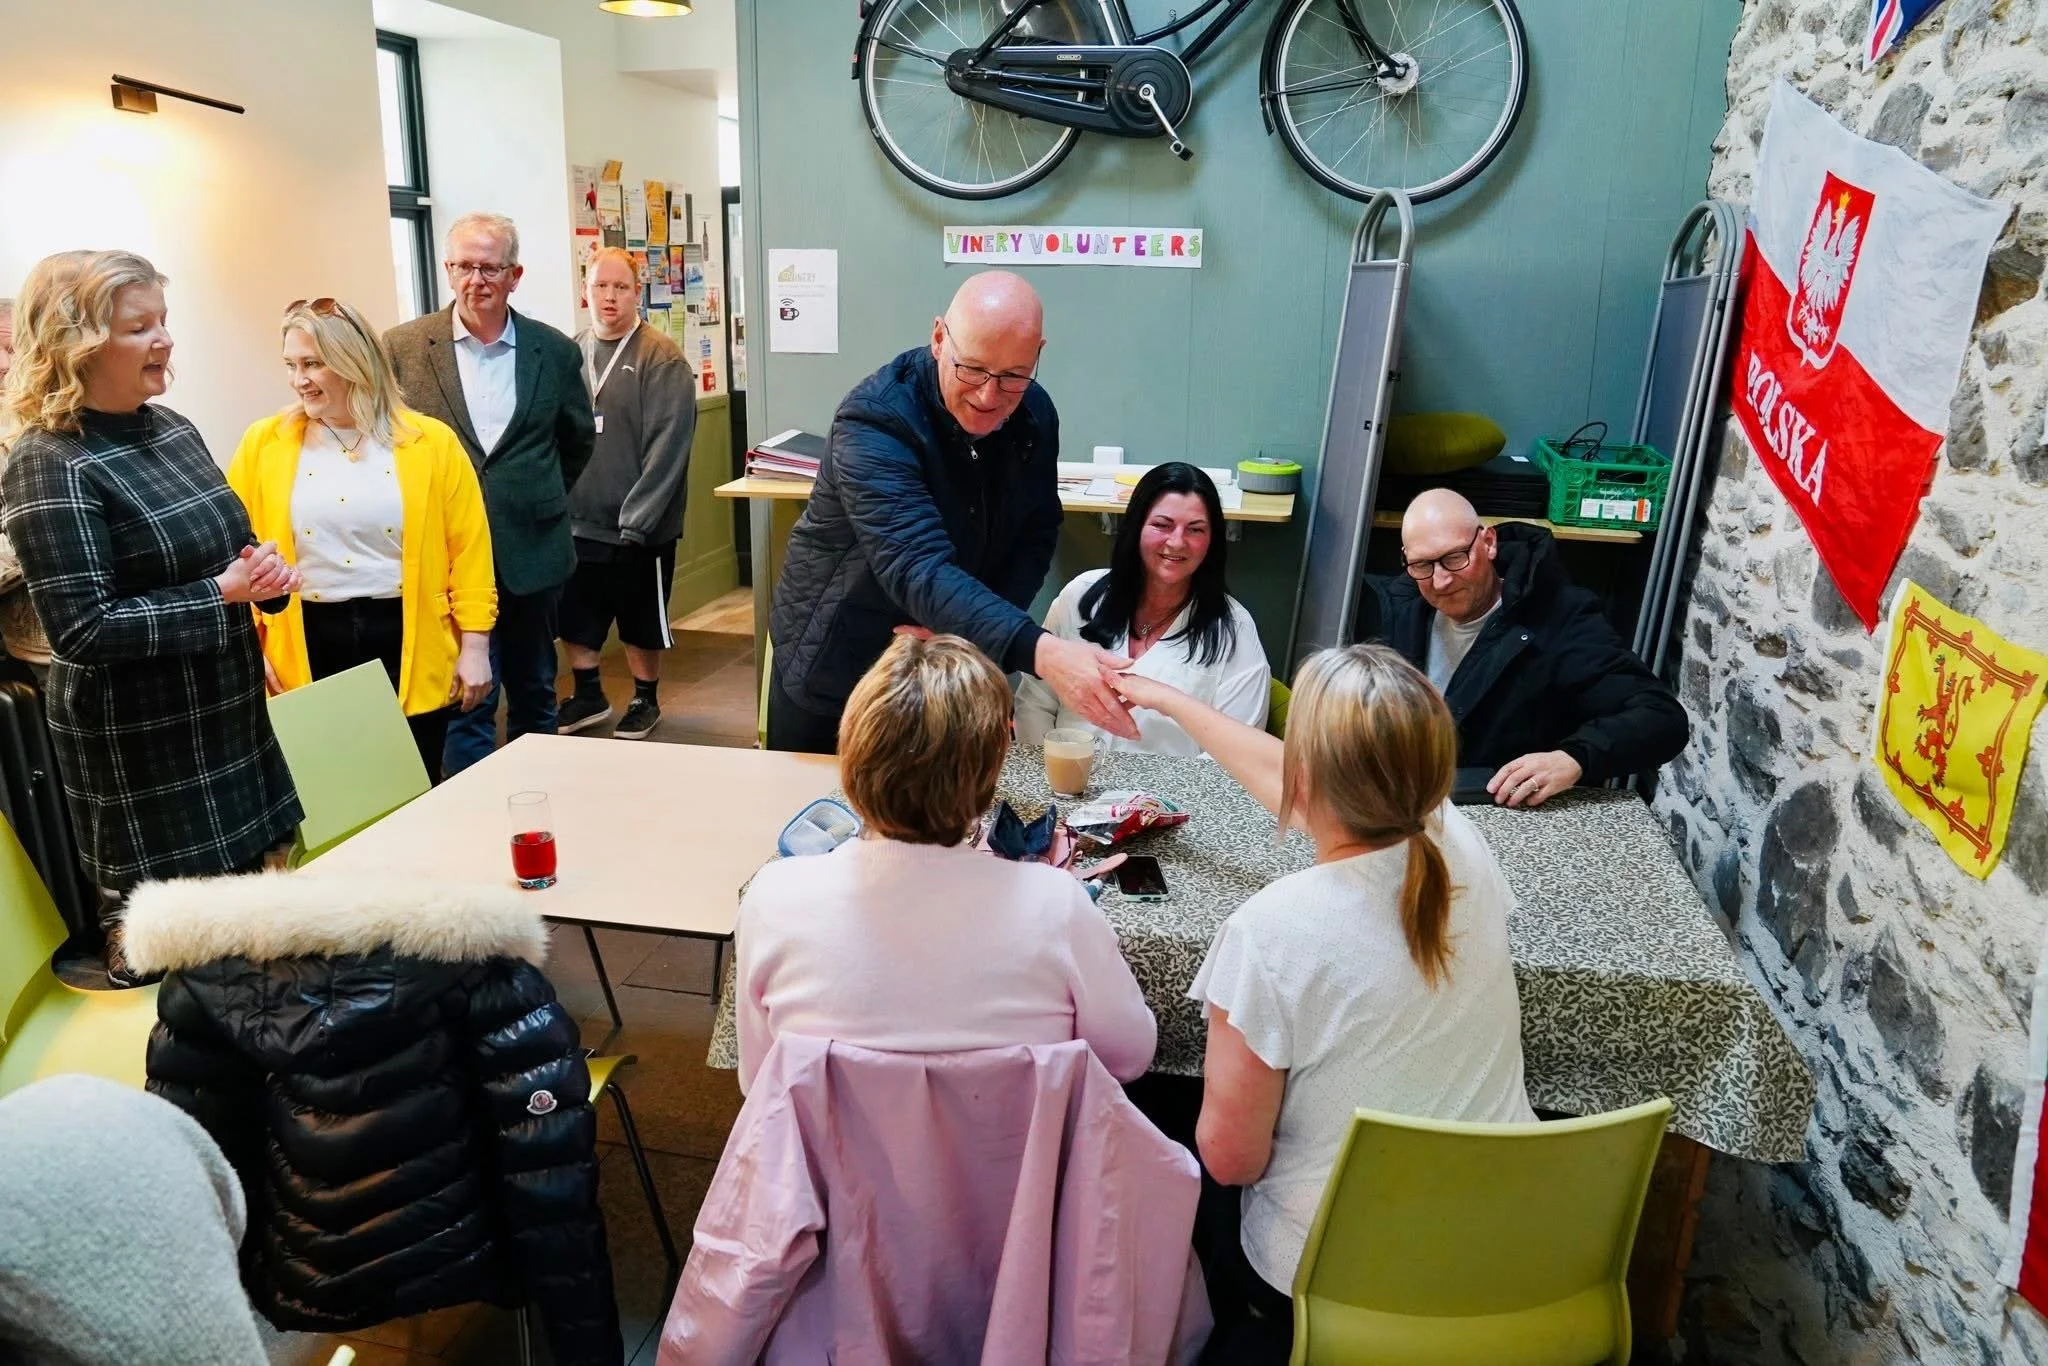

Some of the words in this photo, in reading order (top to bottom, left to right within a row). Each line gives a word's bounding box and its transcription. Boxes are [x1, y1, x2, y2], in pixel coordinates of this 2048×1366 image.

[946, 232, 1023, 254] VINERY
[1029, 233, 1200, 257] VOLUNTEERS
[1746, 350, 1828, 507] POLSKA
